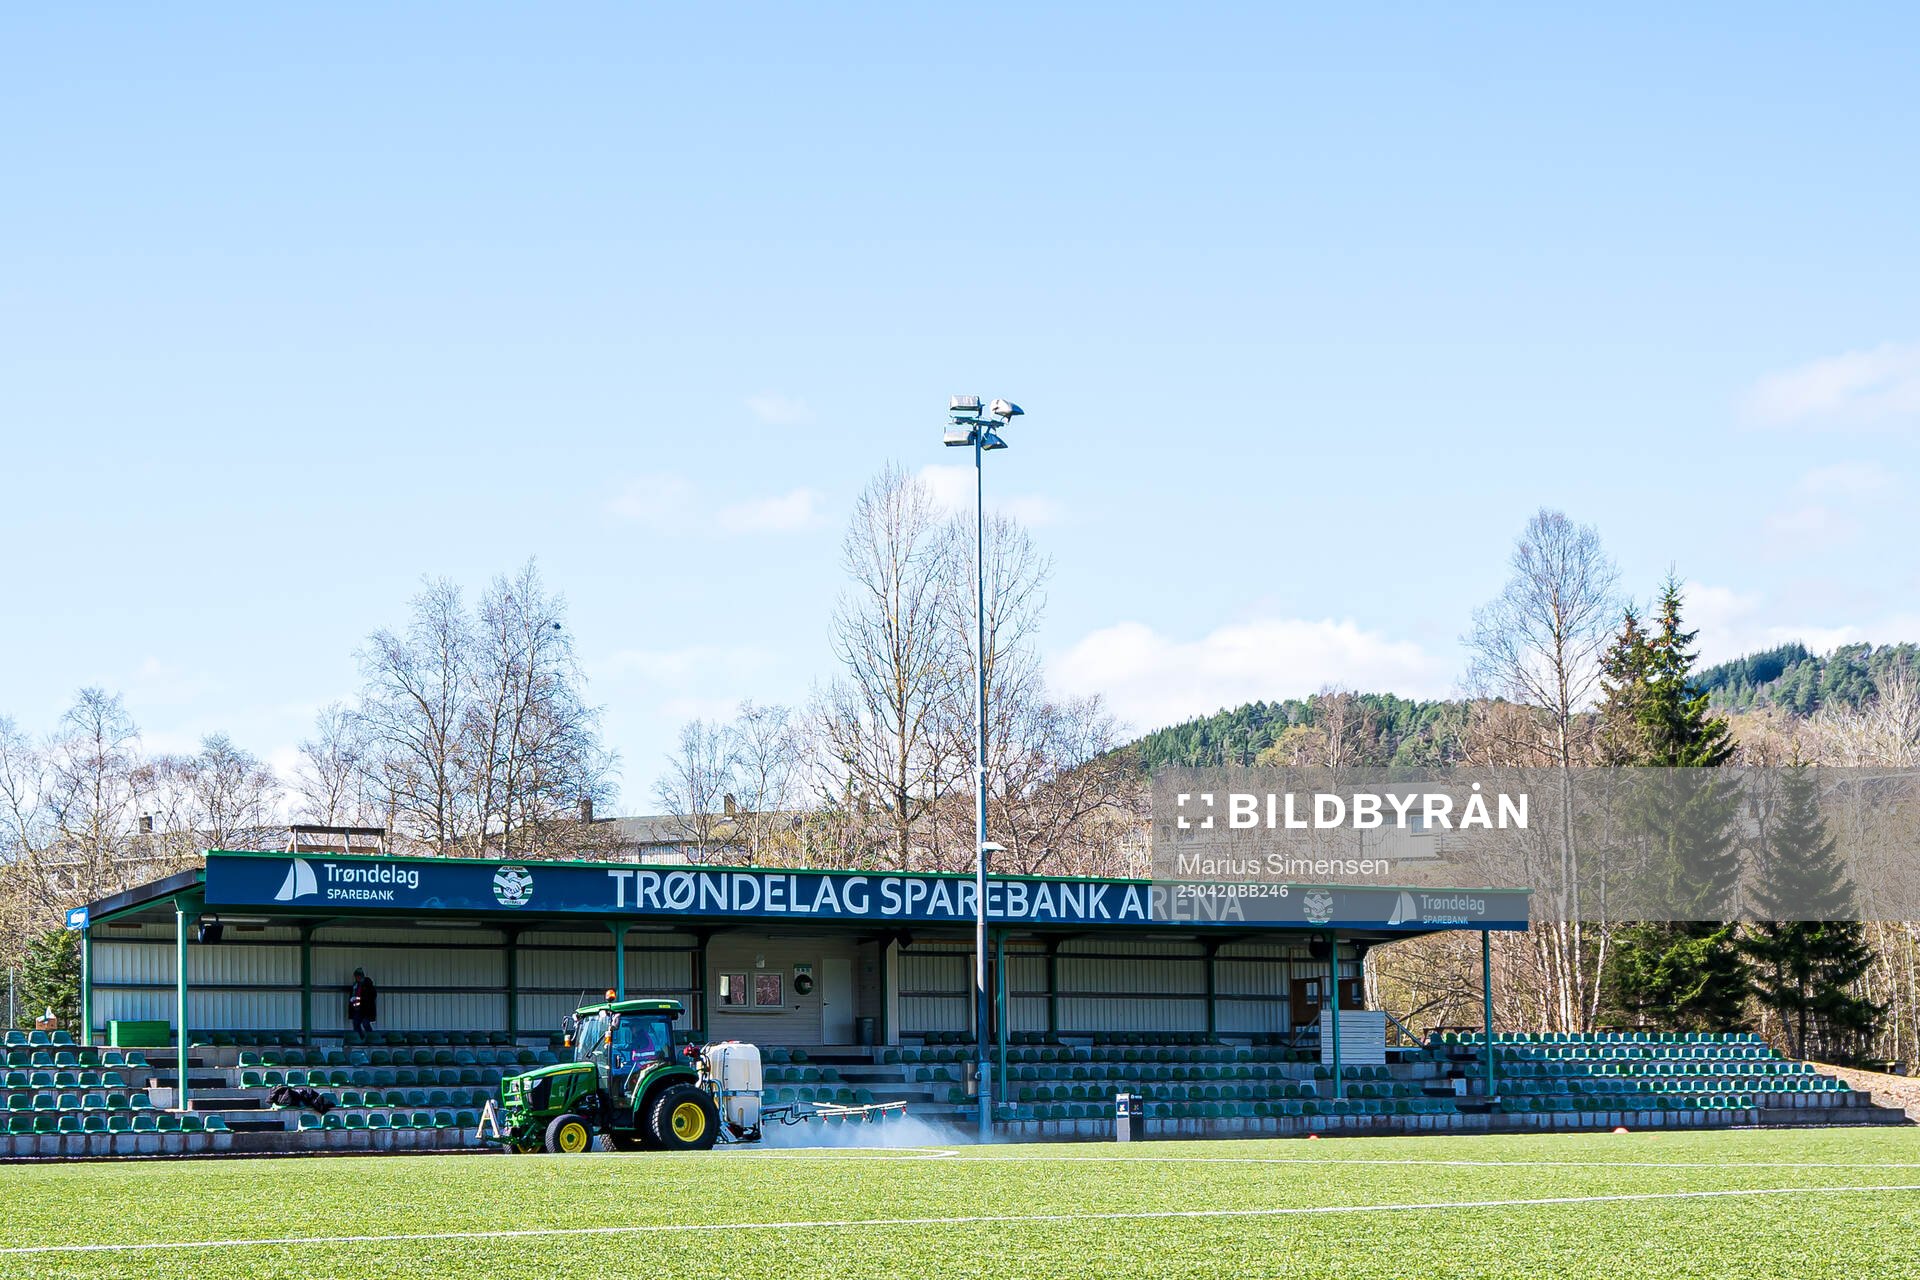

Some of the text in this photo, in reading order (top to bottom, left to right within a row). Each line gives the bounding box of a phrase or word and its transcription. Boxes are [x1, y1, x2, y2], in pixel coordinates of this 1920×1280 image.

[324, 863, 419, 889] Trøndelag
[327, 888, 394, 900] SPAREBANK
[607, 869, 1245, 921] TRØNDELAG SPAREBANK ARENA
[1420, 894, 1485, 915] Trøndelag
[1422, 915, 1469, 925] SPAREBANK
